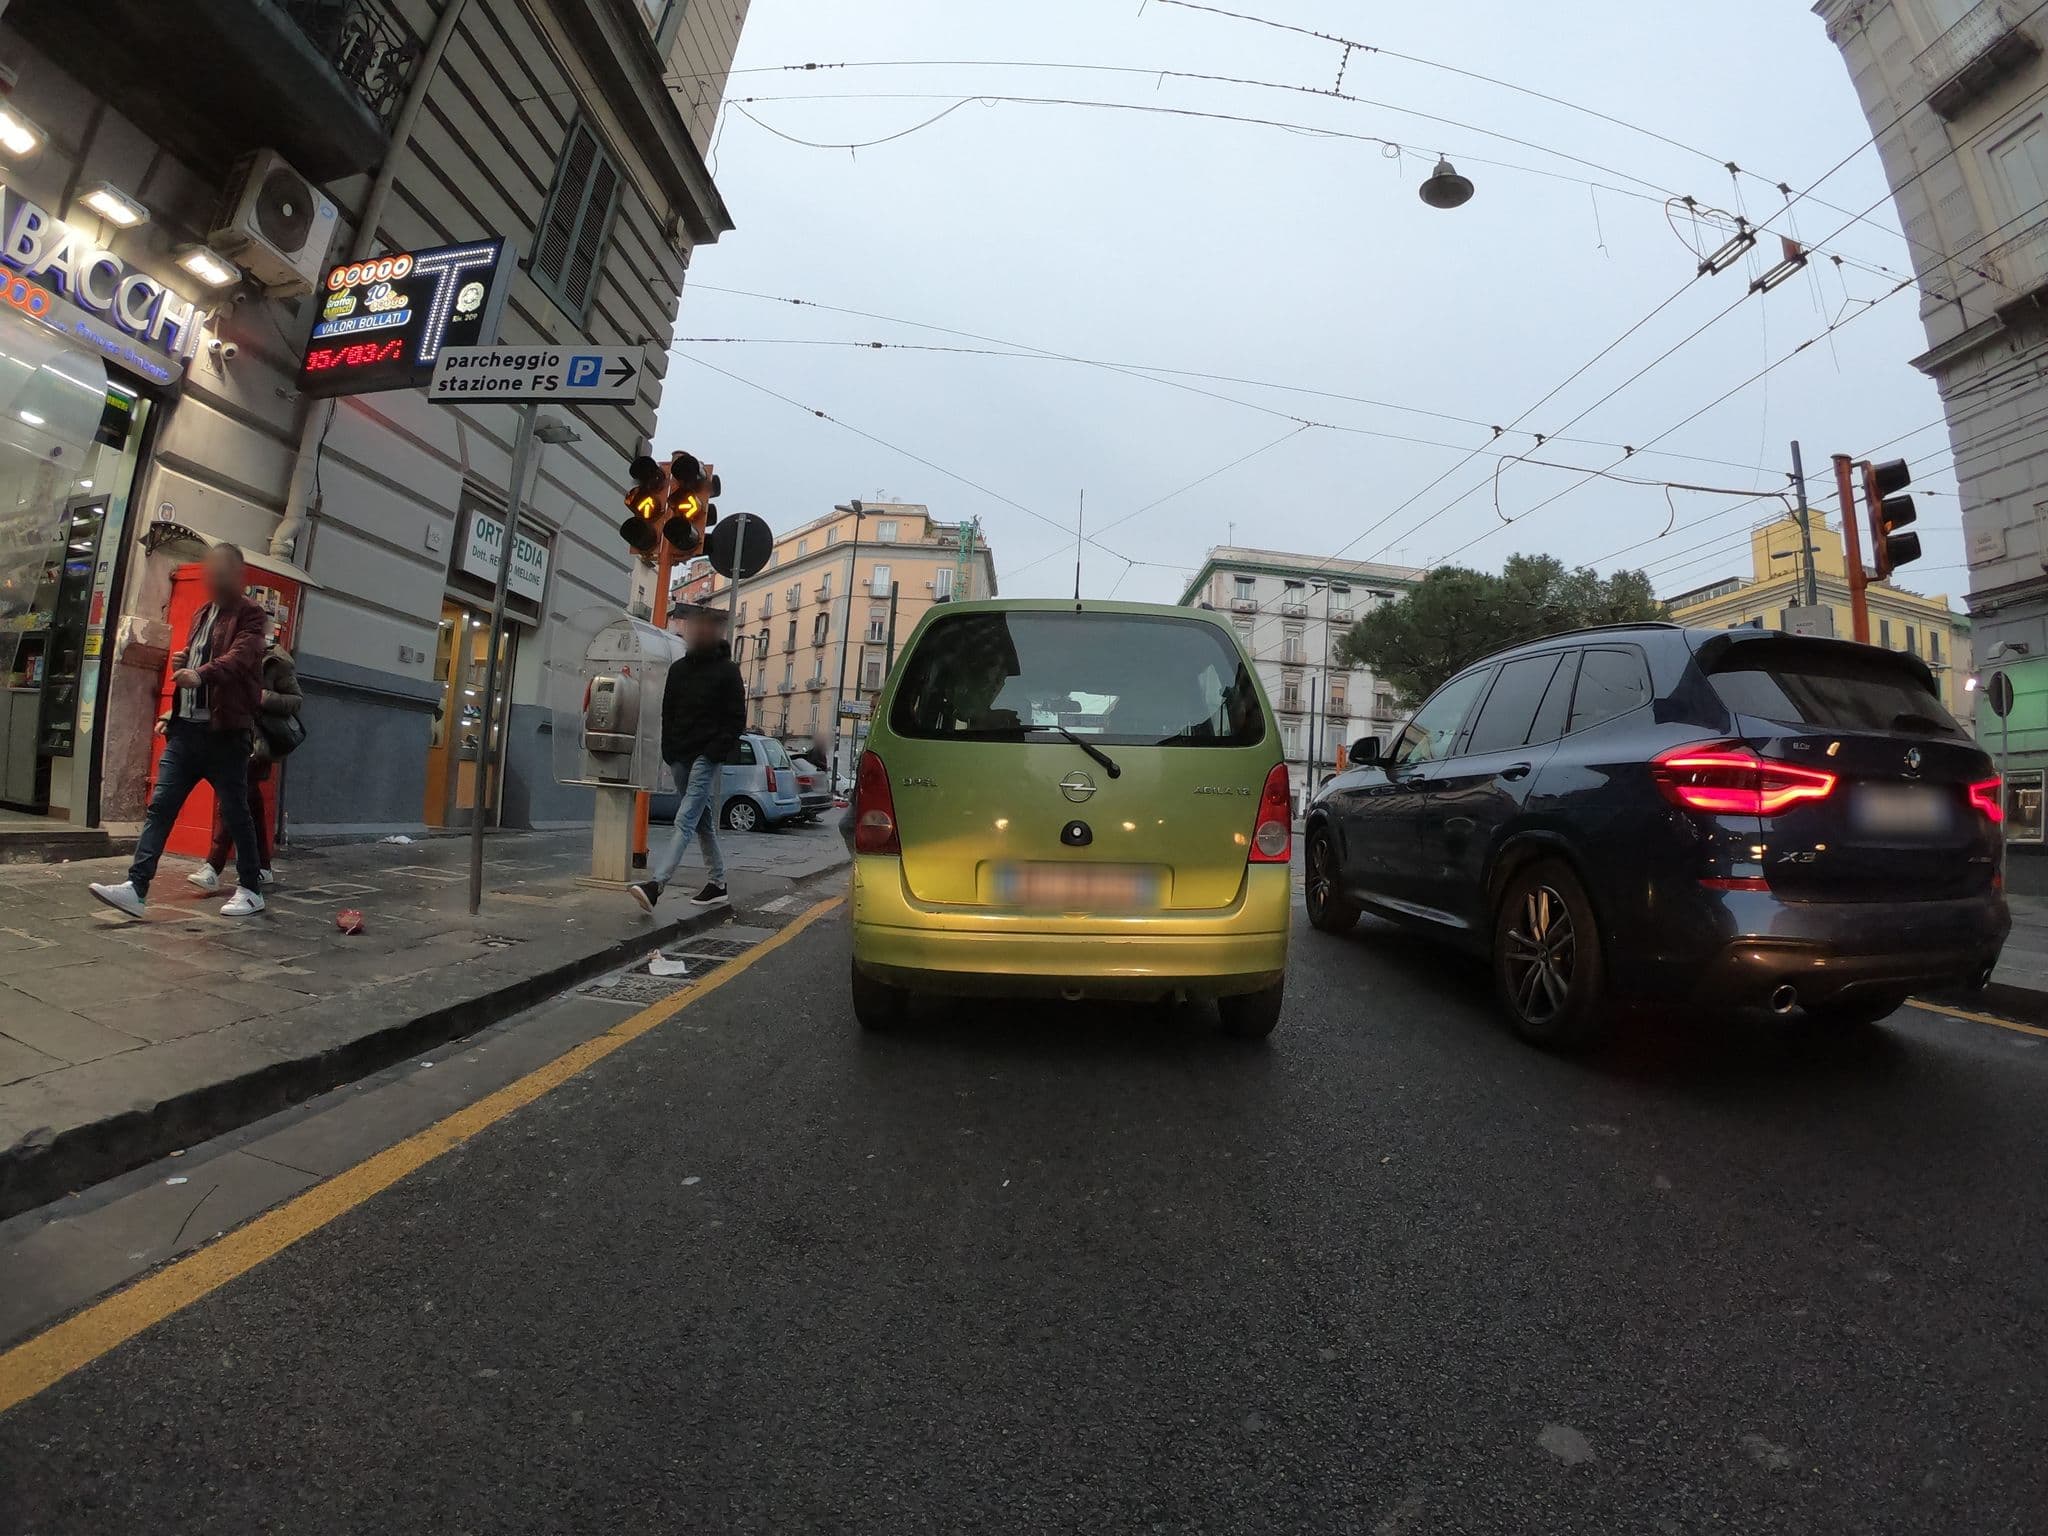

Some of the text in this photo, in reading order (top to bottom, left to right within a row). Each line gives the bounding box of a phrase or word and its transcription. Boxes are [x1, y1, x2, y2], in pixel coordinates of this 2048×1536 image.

[330, 256, 410, 287] LOTTO
[366, 283, 391, 305] 10
[322, 312, 402, 335] VALORI BOLLATI
[445, 351, 560, 371] parcheggio
[574, 359, 596, 384] P
[438, 375, 560, 392] stazione FS
[476, 518, 543, 569] ORTPEDIA
[1777, 851, 1817, 864] X3
